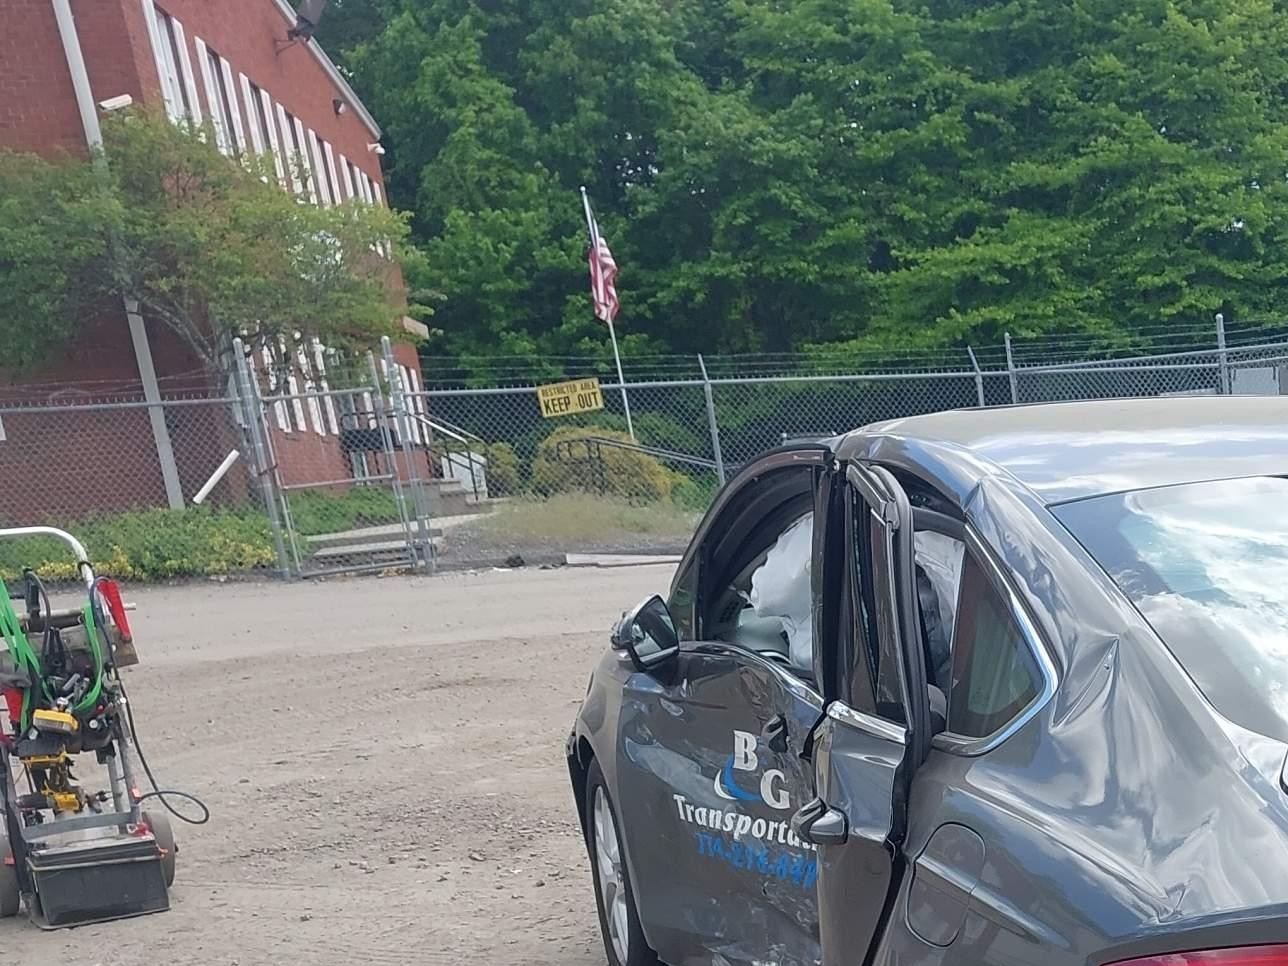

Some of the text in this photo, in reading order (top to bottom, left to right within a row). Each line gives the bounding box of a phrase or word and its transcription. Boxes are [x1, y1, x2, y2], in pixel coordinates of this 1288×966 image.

[541, 381, 597, 396] RESTRICTED AREA
[543, 391, 599, 415] KEEP OUT
[732, 730, 759, 771] B
[760, 769, 791, 810] G
[673, 794, 818, 851] Transporta
